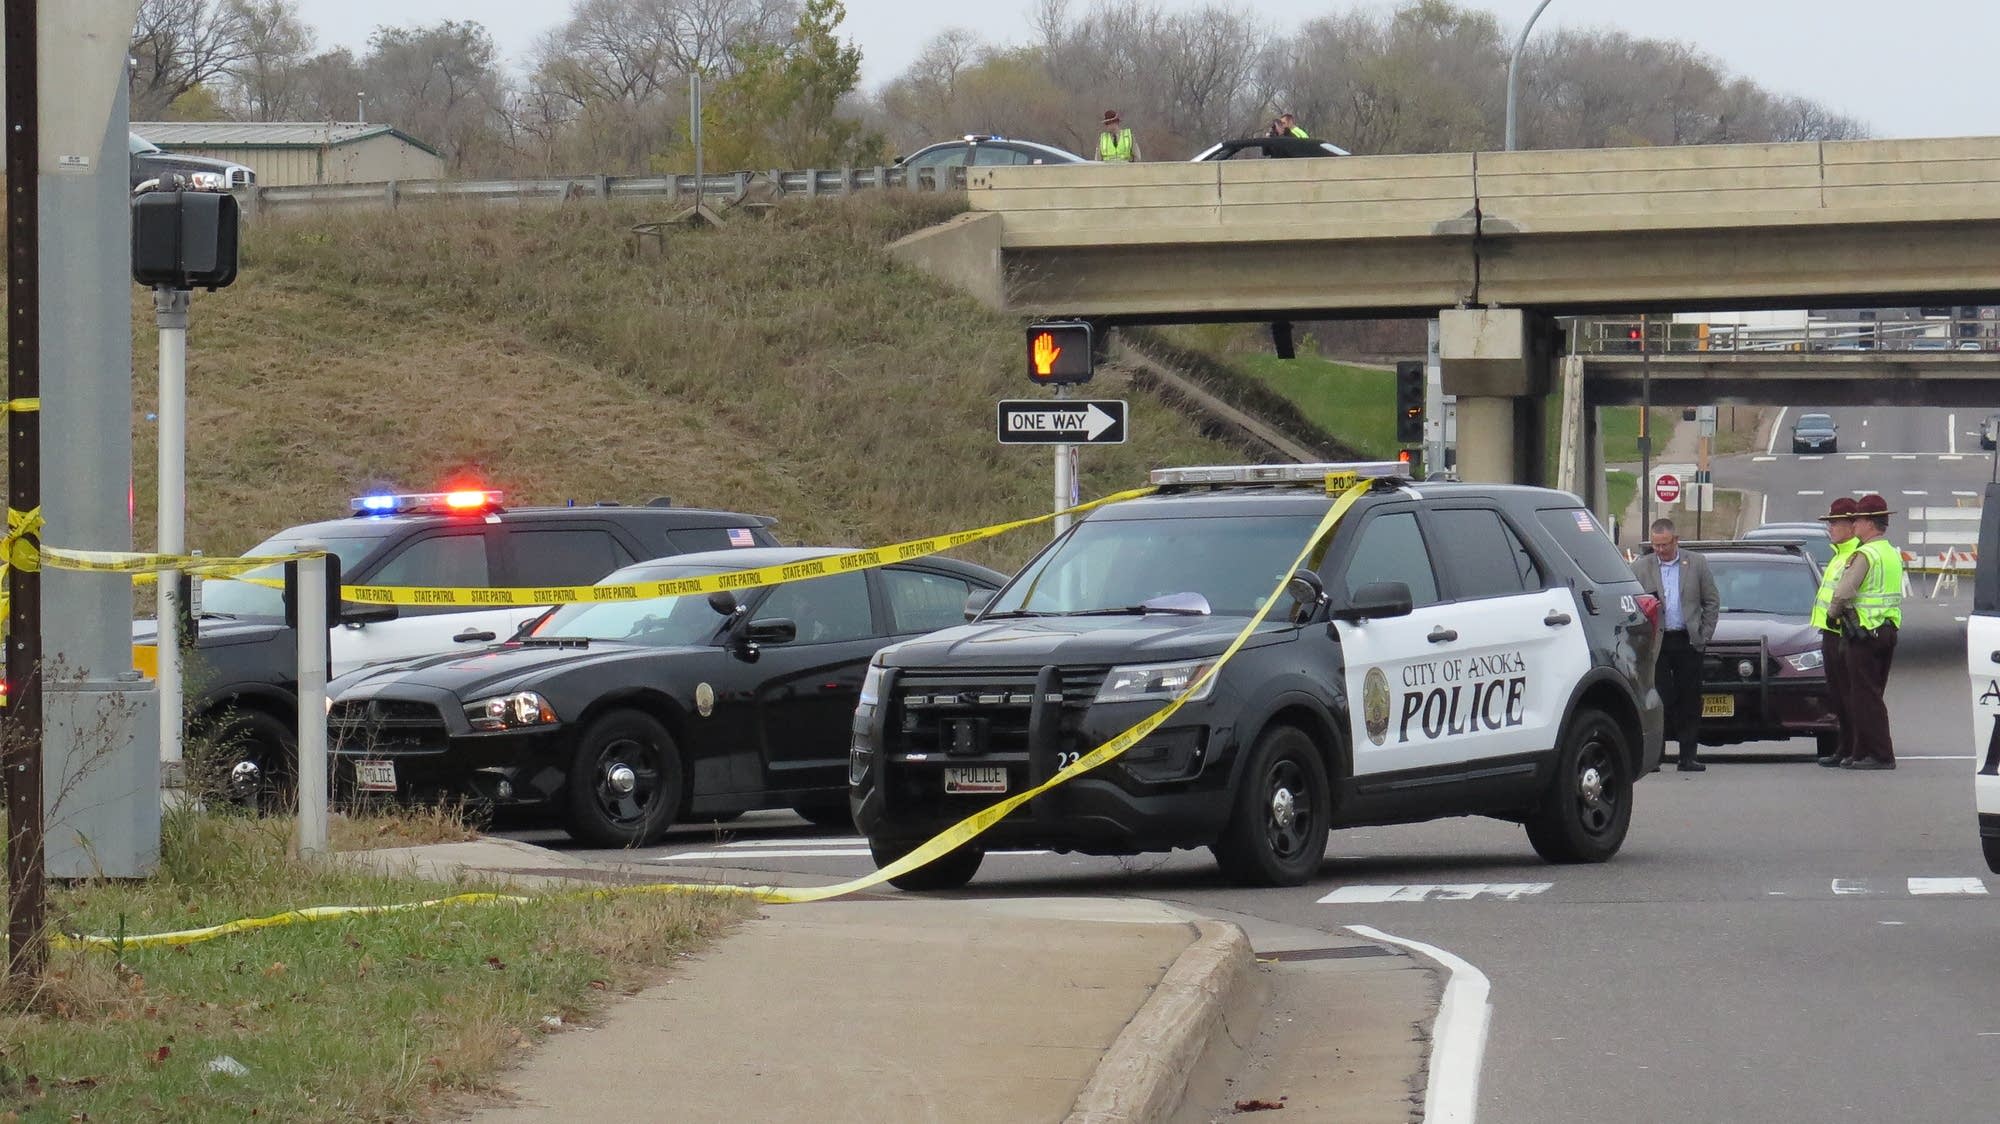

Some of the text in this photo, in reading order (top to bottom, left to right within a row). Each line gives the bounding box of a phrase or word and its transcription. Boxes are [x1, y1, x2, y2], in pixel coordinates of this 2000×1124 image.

[1012, 413, 1087, 430] ONE WAY
[899, 540, 936, 559] STATE PATROL
[840, 551, 882, 570] STATE PATROL
[782, 561, 826, 580] STATE PATROL
[658, 579, 703, 597] STATE PATROL
[718, 572, 762, 589] STATE PATROL
[355, 588, 395, 603] STATE PATROL
[414, 590, 456, 603] STATE PATROL
[471, 590, 514, 603] STATE PATROL
[534, 589, 578, 602] STATE PATROL
[593, 586, 638, 600] STATE PATROL
[1620, 595, 1637, 612] 423
[1402, 650, 1526, 688] CITY OF ANOKA
[1706, 696, 1728, 705] STATE
[1398, 676, 1526, 743] POLICE
[1705, 705, 1731, 713] PATROL
[364, 767, 393, 783] POLICE
[961, 767, 1002, 783] POLICE
